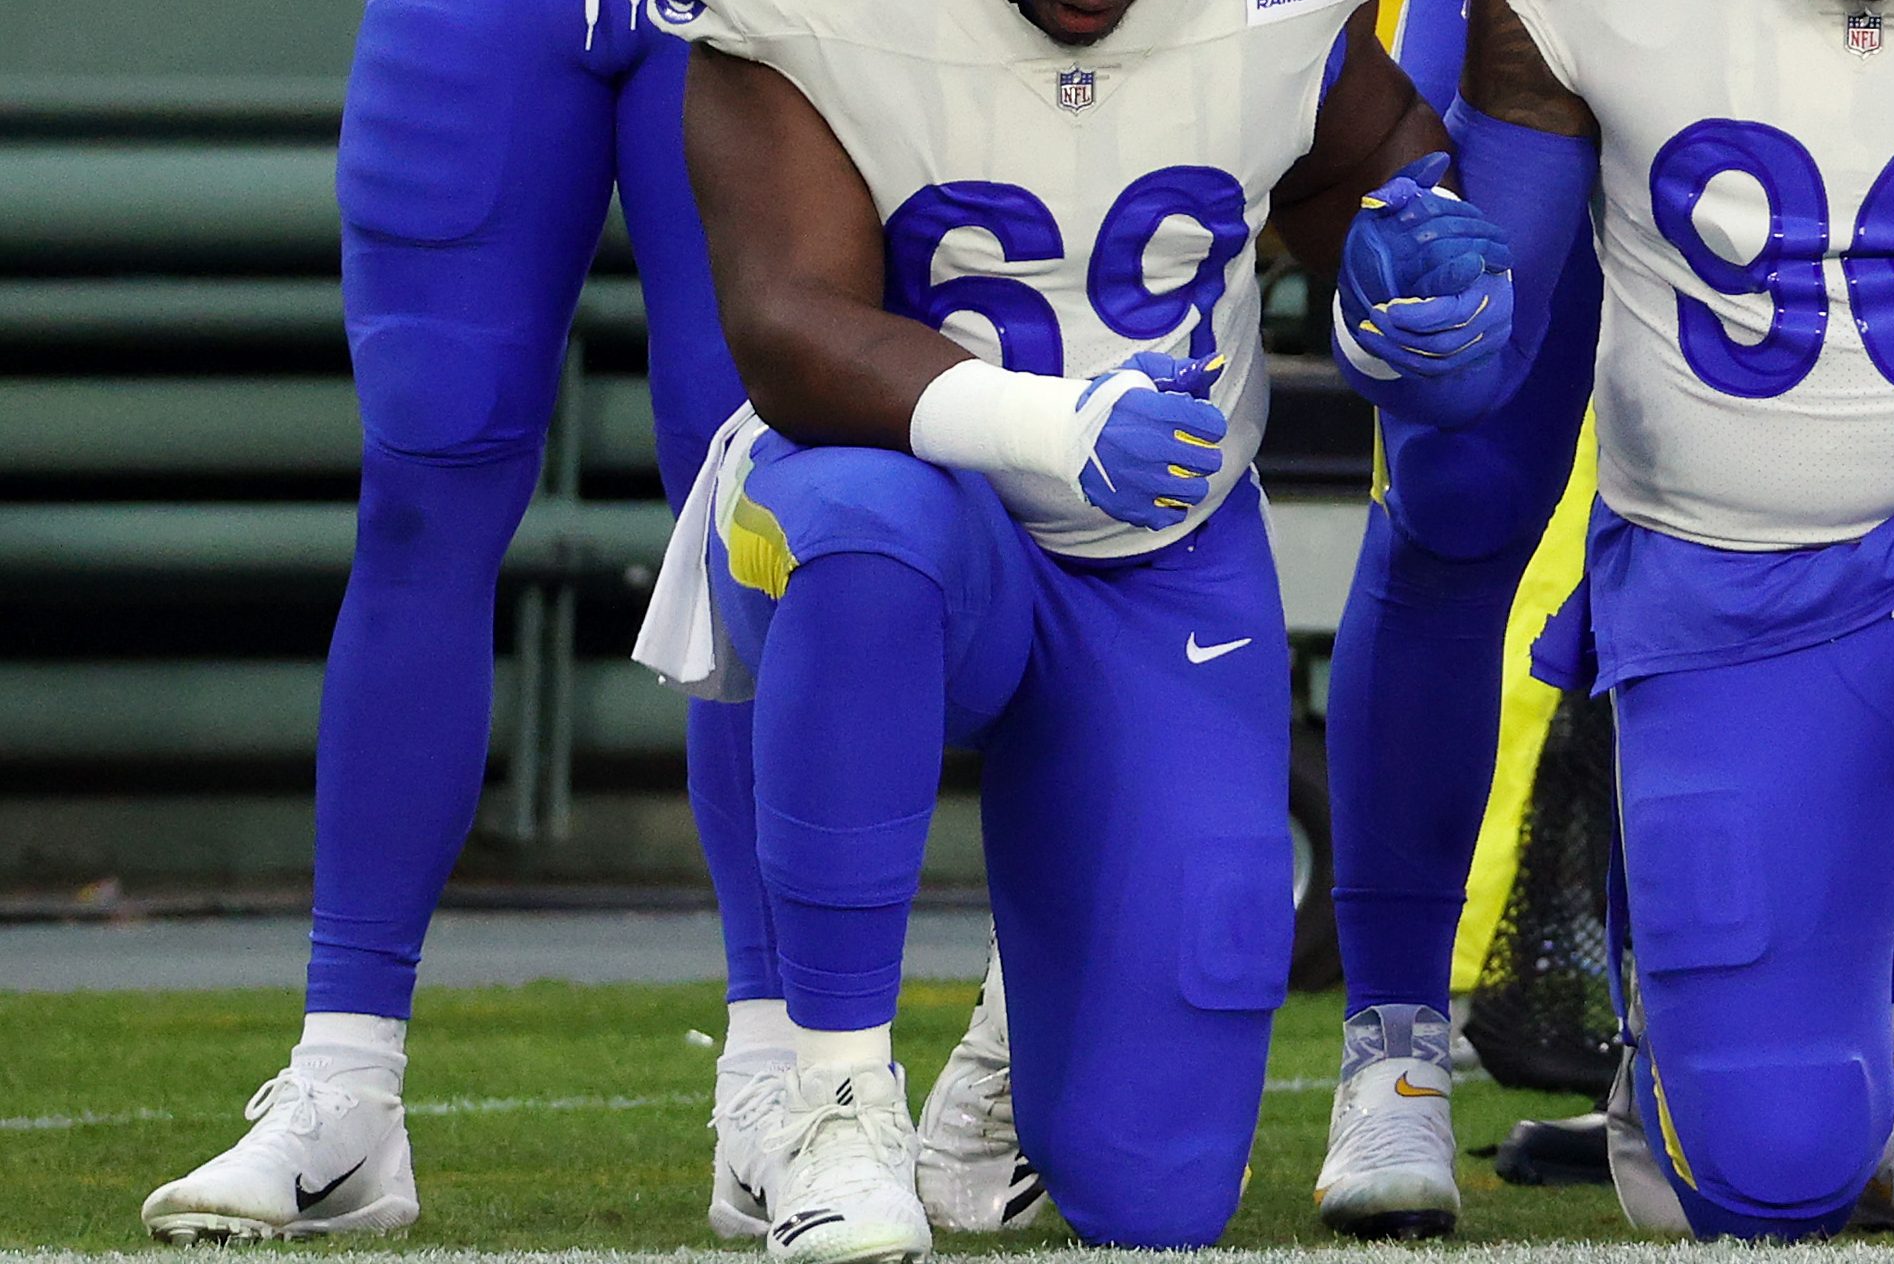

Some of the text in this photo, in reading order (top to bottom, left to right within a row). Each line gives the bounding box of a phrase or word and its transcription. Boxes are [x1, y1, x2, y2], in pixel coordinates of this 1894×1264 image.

[1851, 30, 1877, 49] NFL
[1063, 86, 1091, 105] NFL
[884, 165, 1249, 379] 69
